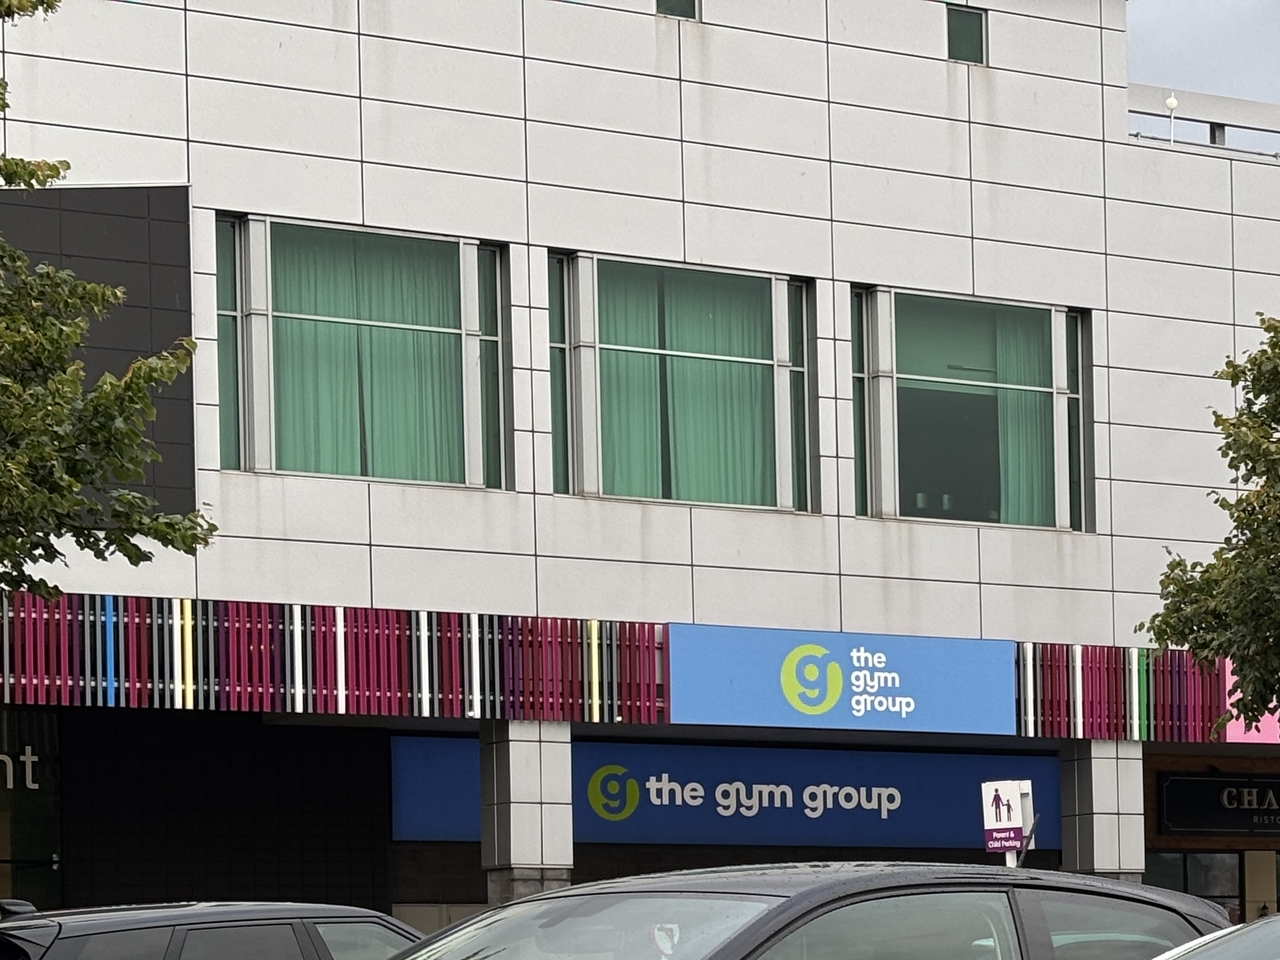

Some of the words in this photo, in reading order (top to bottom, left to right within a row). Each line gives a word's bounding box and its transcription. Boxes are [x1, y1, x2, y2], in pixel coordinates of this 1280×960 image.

[850, 647, 886, 668] the
[850, 670, 900, 693] gym
[851, 694, 915, 718] group
[645, 773, 705, 806] the
[715, 781, 793, 817] gym
[802, 783, 902, 819] group
